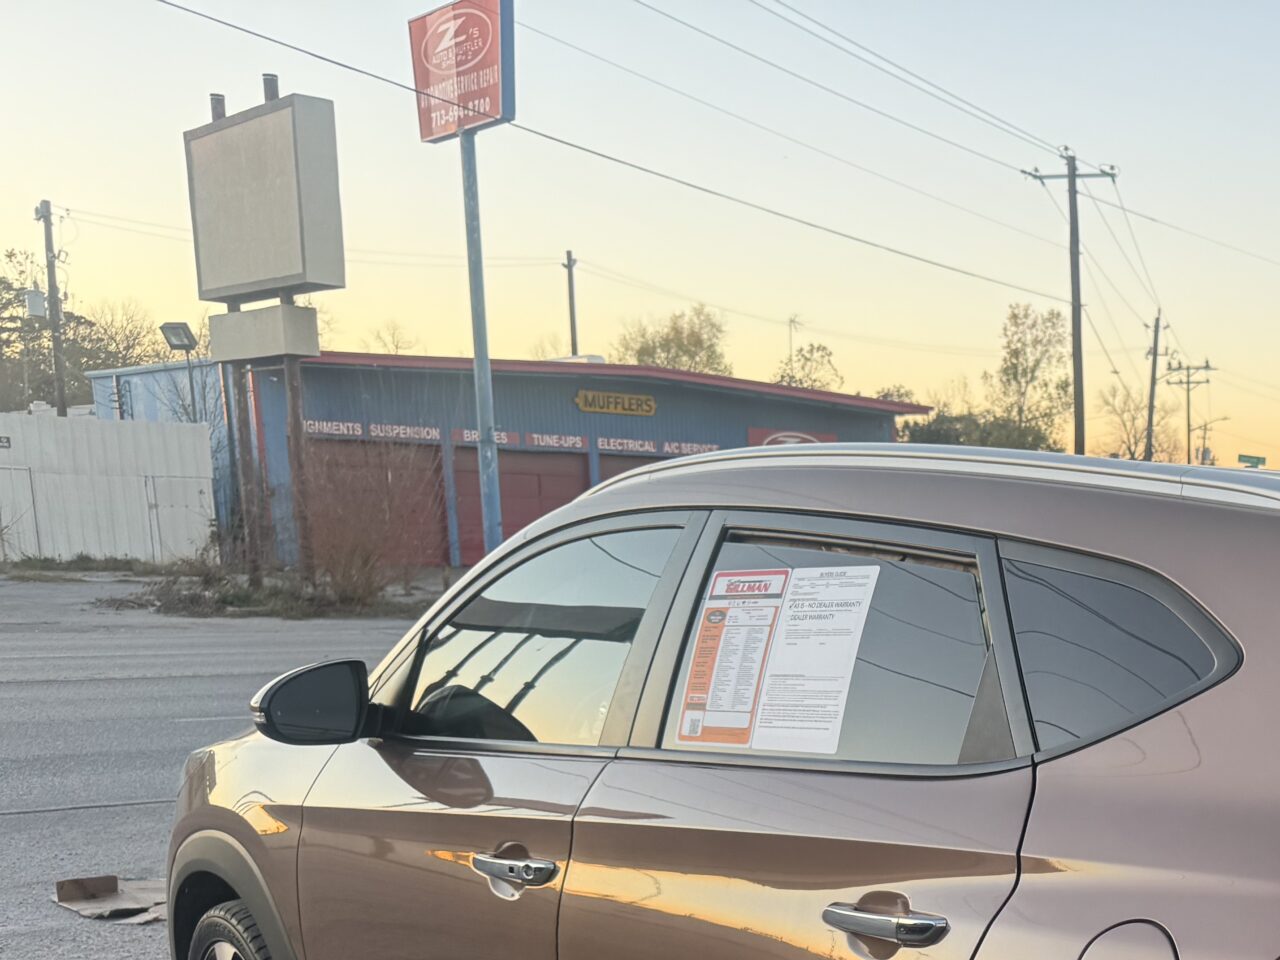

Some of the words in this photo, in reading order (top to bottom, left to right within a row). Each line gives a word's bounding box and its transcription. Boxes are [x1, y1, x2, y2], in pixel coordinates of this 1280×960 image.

[583, 394, 653, 413] MUFFLERS
[303, 420, 363, 436] IGNMENTS
[369, 424, 441, 440] SUSPENSION
[463, 430, 508, 444] BRES
[532, 433, 583, 448] TUNE-UPS
[598, 437, 657, 453] ELECTRICAL
